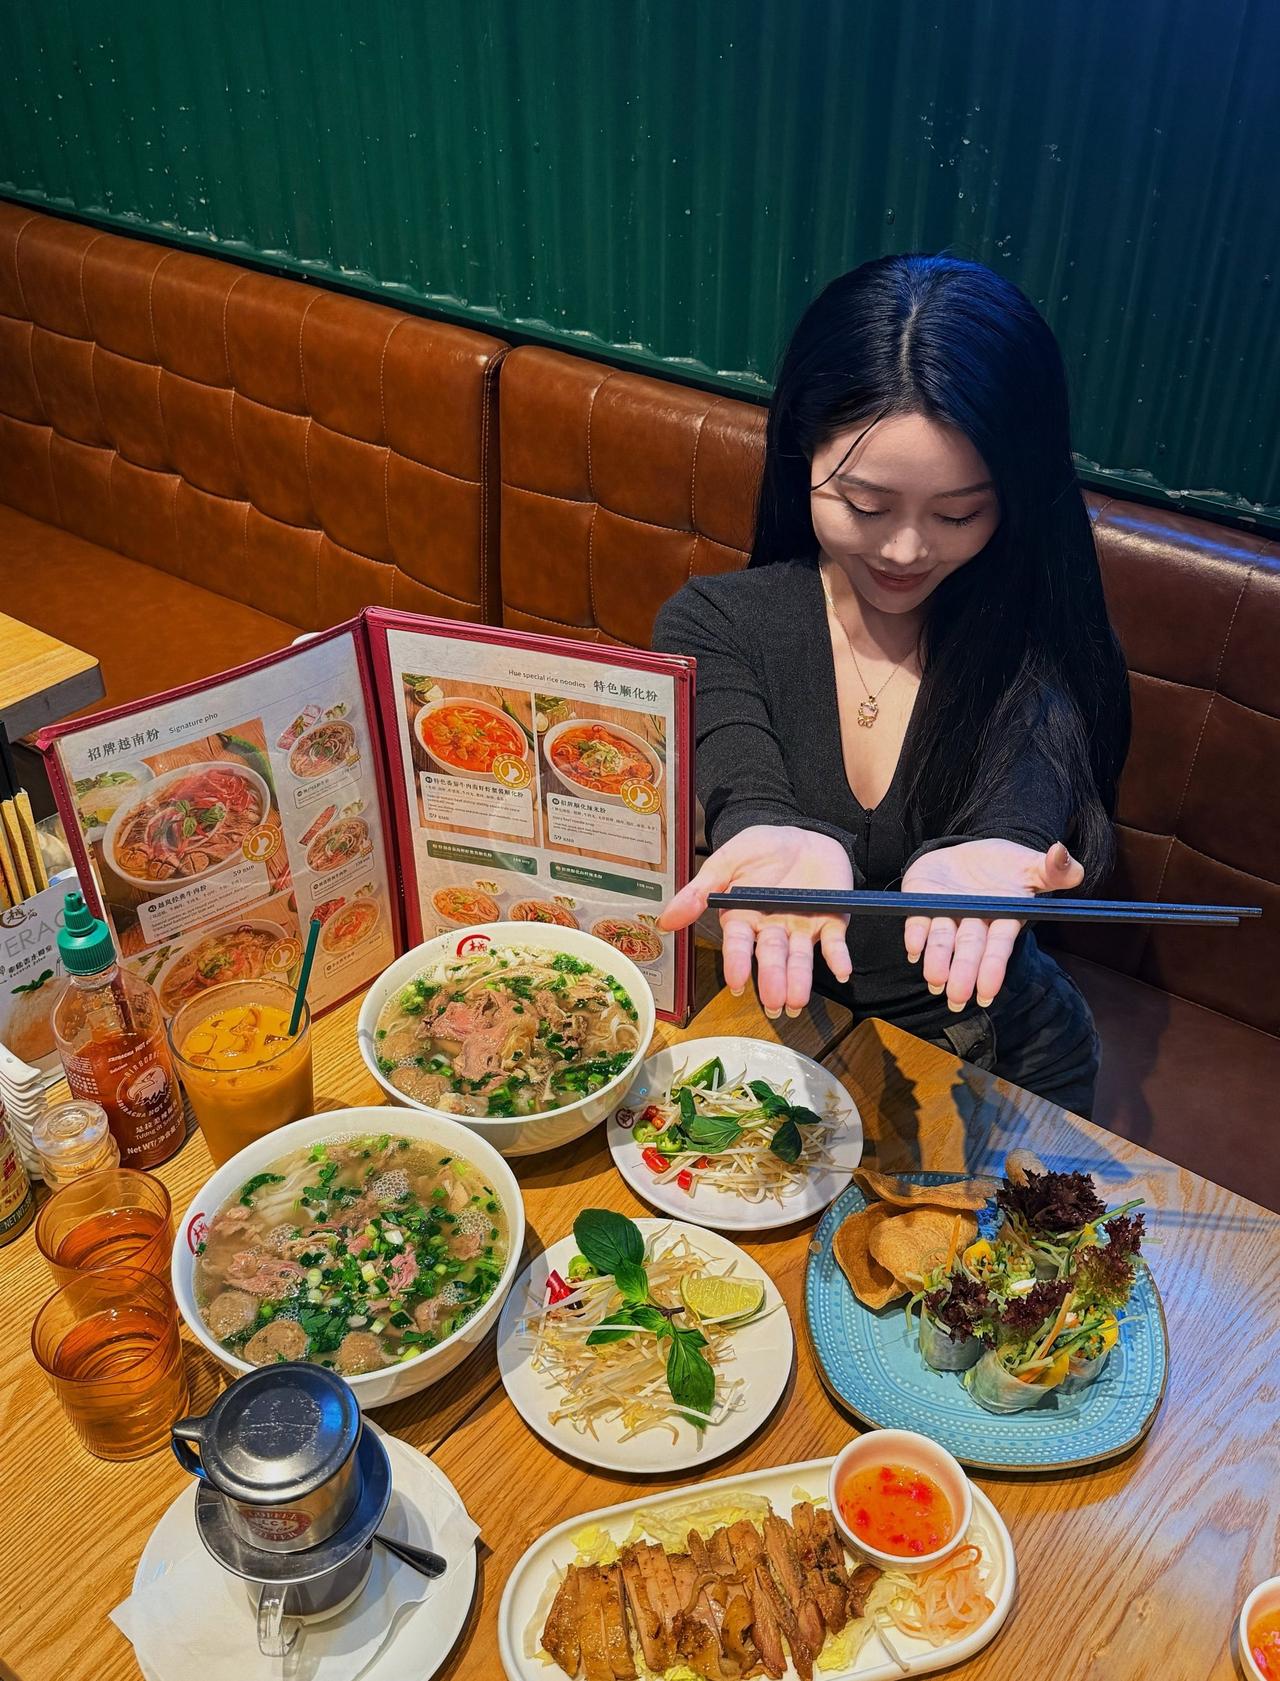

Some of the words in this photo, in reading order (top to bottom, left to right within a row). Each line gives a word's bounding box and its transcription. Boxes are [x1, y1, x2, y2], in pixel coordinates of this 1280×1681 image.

[508, 669, 521, 677] Hue
[523, 672, 545, 682] special
[547, 675, 559, 683] rice
[168, 719, 203, 735] Signature
[204, 712, 218, 724] pho
[88, 727, 160, 761] 招牌越南粉
[232, 868, 242, 877] 59
[126, 1143, 142, 1156] Net
